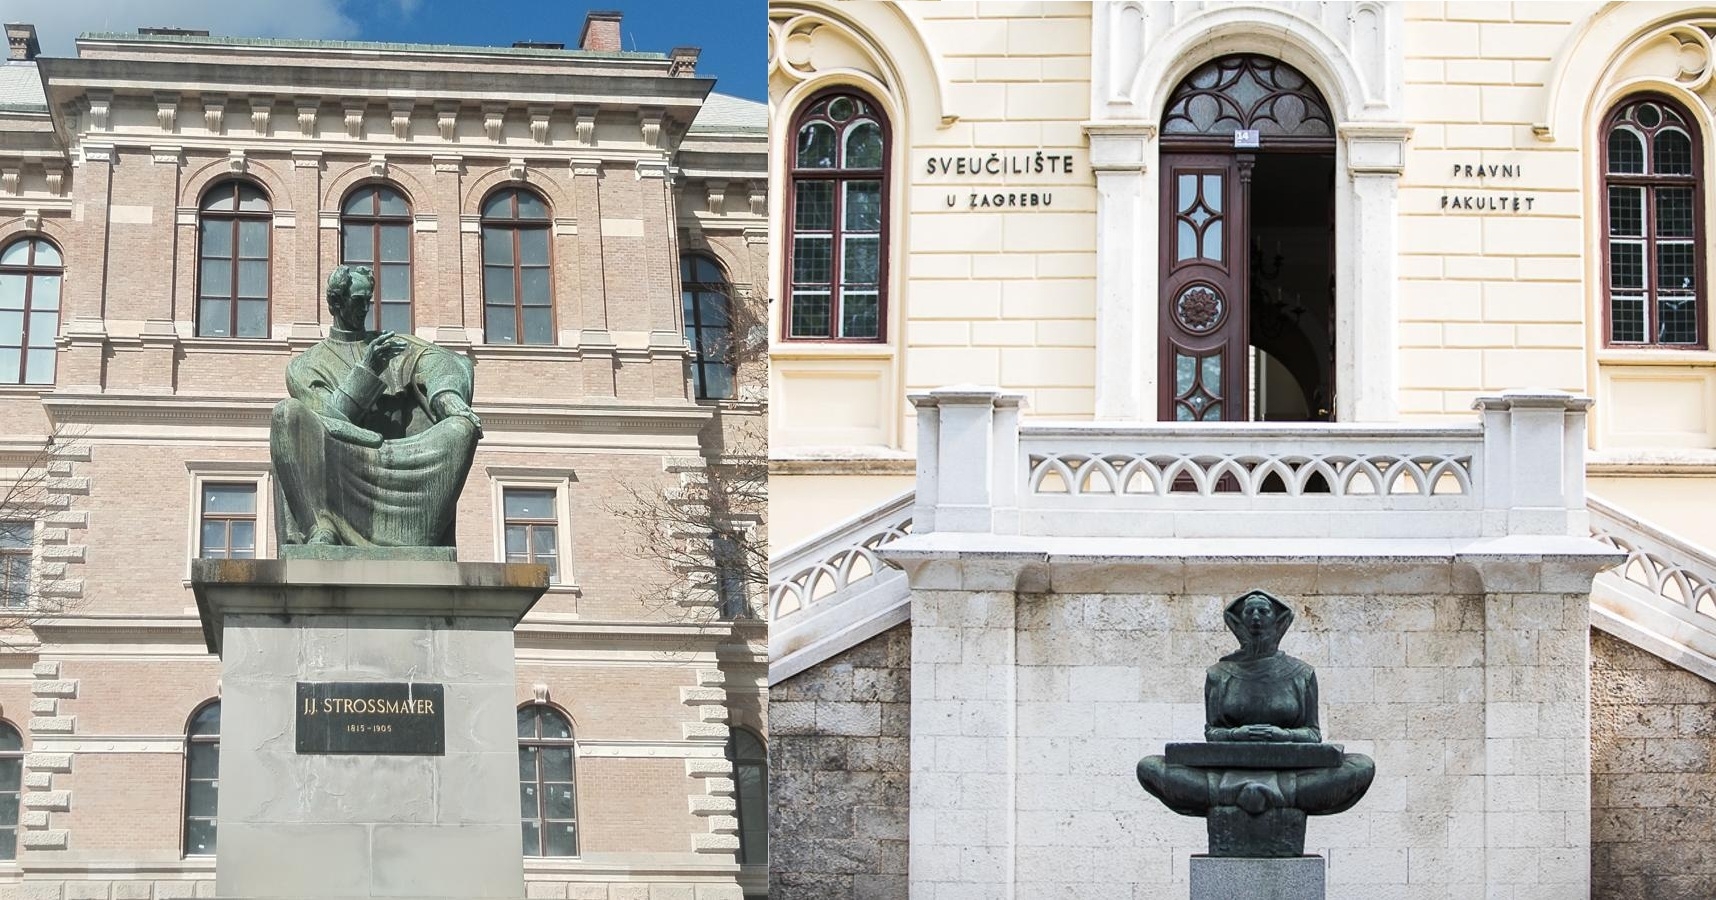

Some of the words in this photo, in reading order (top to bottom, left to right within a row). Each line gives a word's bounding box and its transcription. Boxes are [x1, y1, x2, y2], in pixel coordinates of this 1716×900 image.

[926, 151, 1073, 175] SVEUČILIŠTE
[1453, 164, 1521, 178] PRAVNI
[946, 194, 956, 207] U
[969, 192, 1052, 207] ZAGREBU
[1440, 196, 1535, 211] FAKULTET
[323, 698, 435, 714] STROSSMAYER
